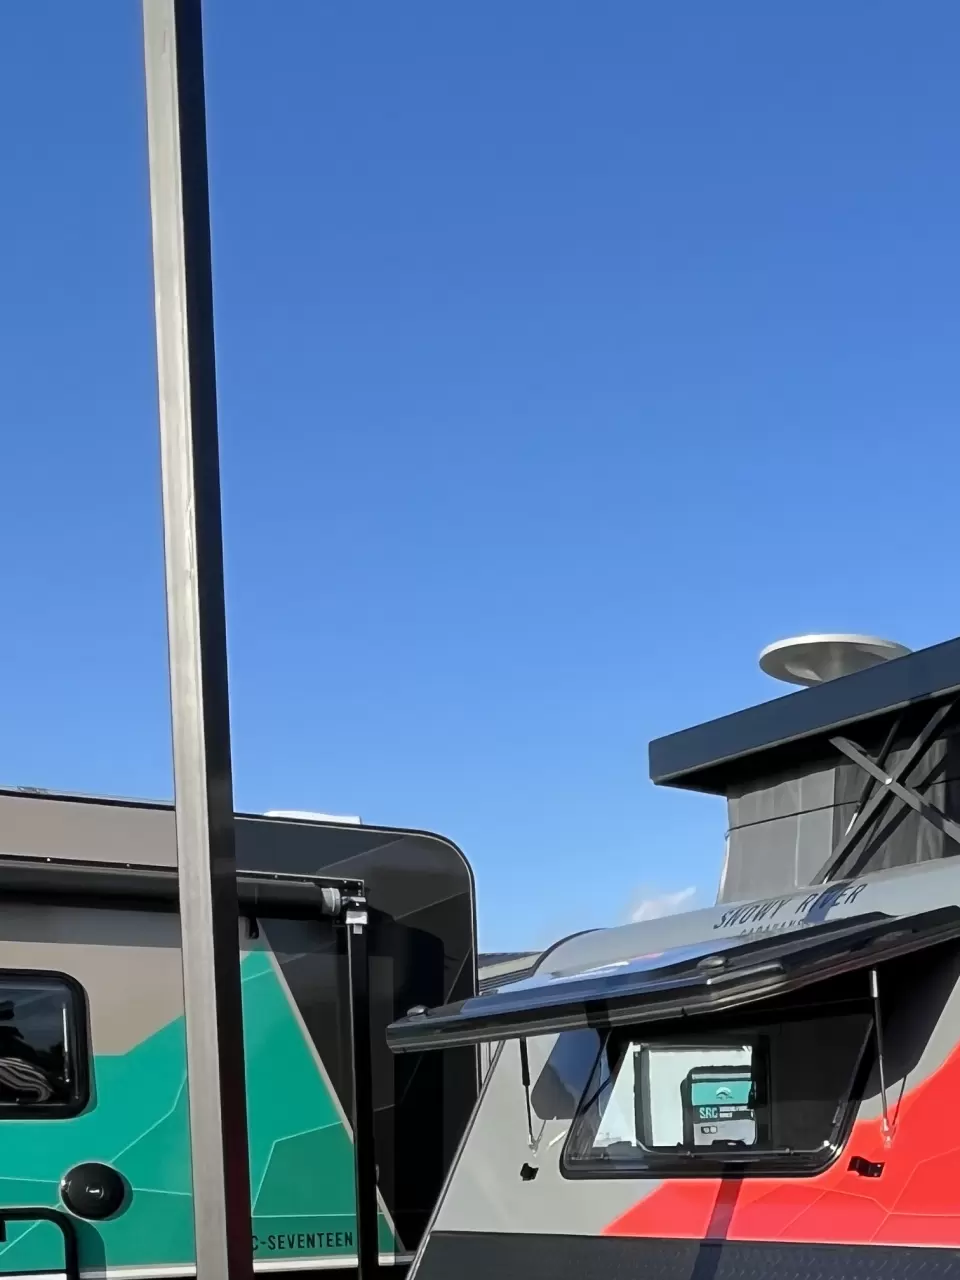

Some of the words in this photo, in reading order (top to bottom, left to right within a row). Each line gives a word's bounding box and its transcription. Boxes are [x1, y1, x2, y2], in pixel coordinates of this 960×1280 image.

[713, 898, 792, 929] SNOWY
[795, 883, 868, 914] RIVER
[699, 1107, 718, 1119] SRC
